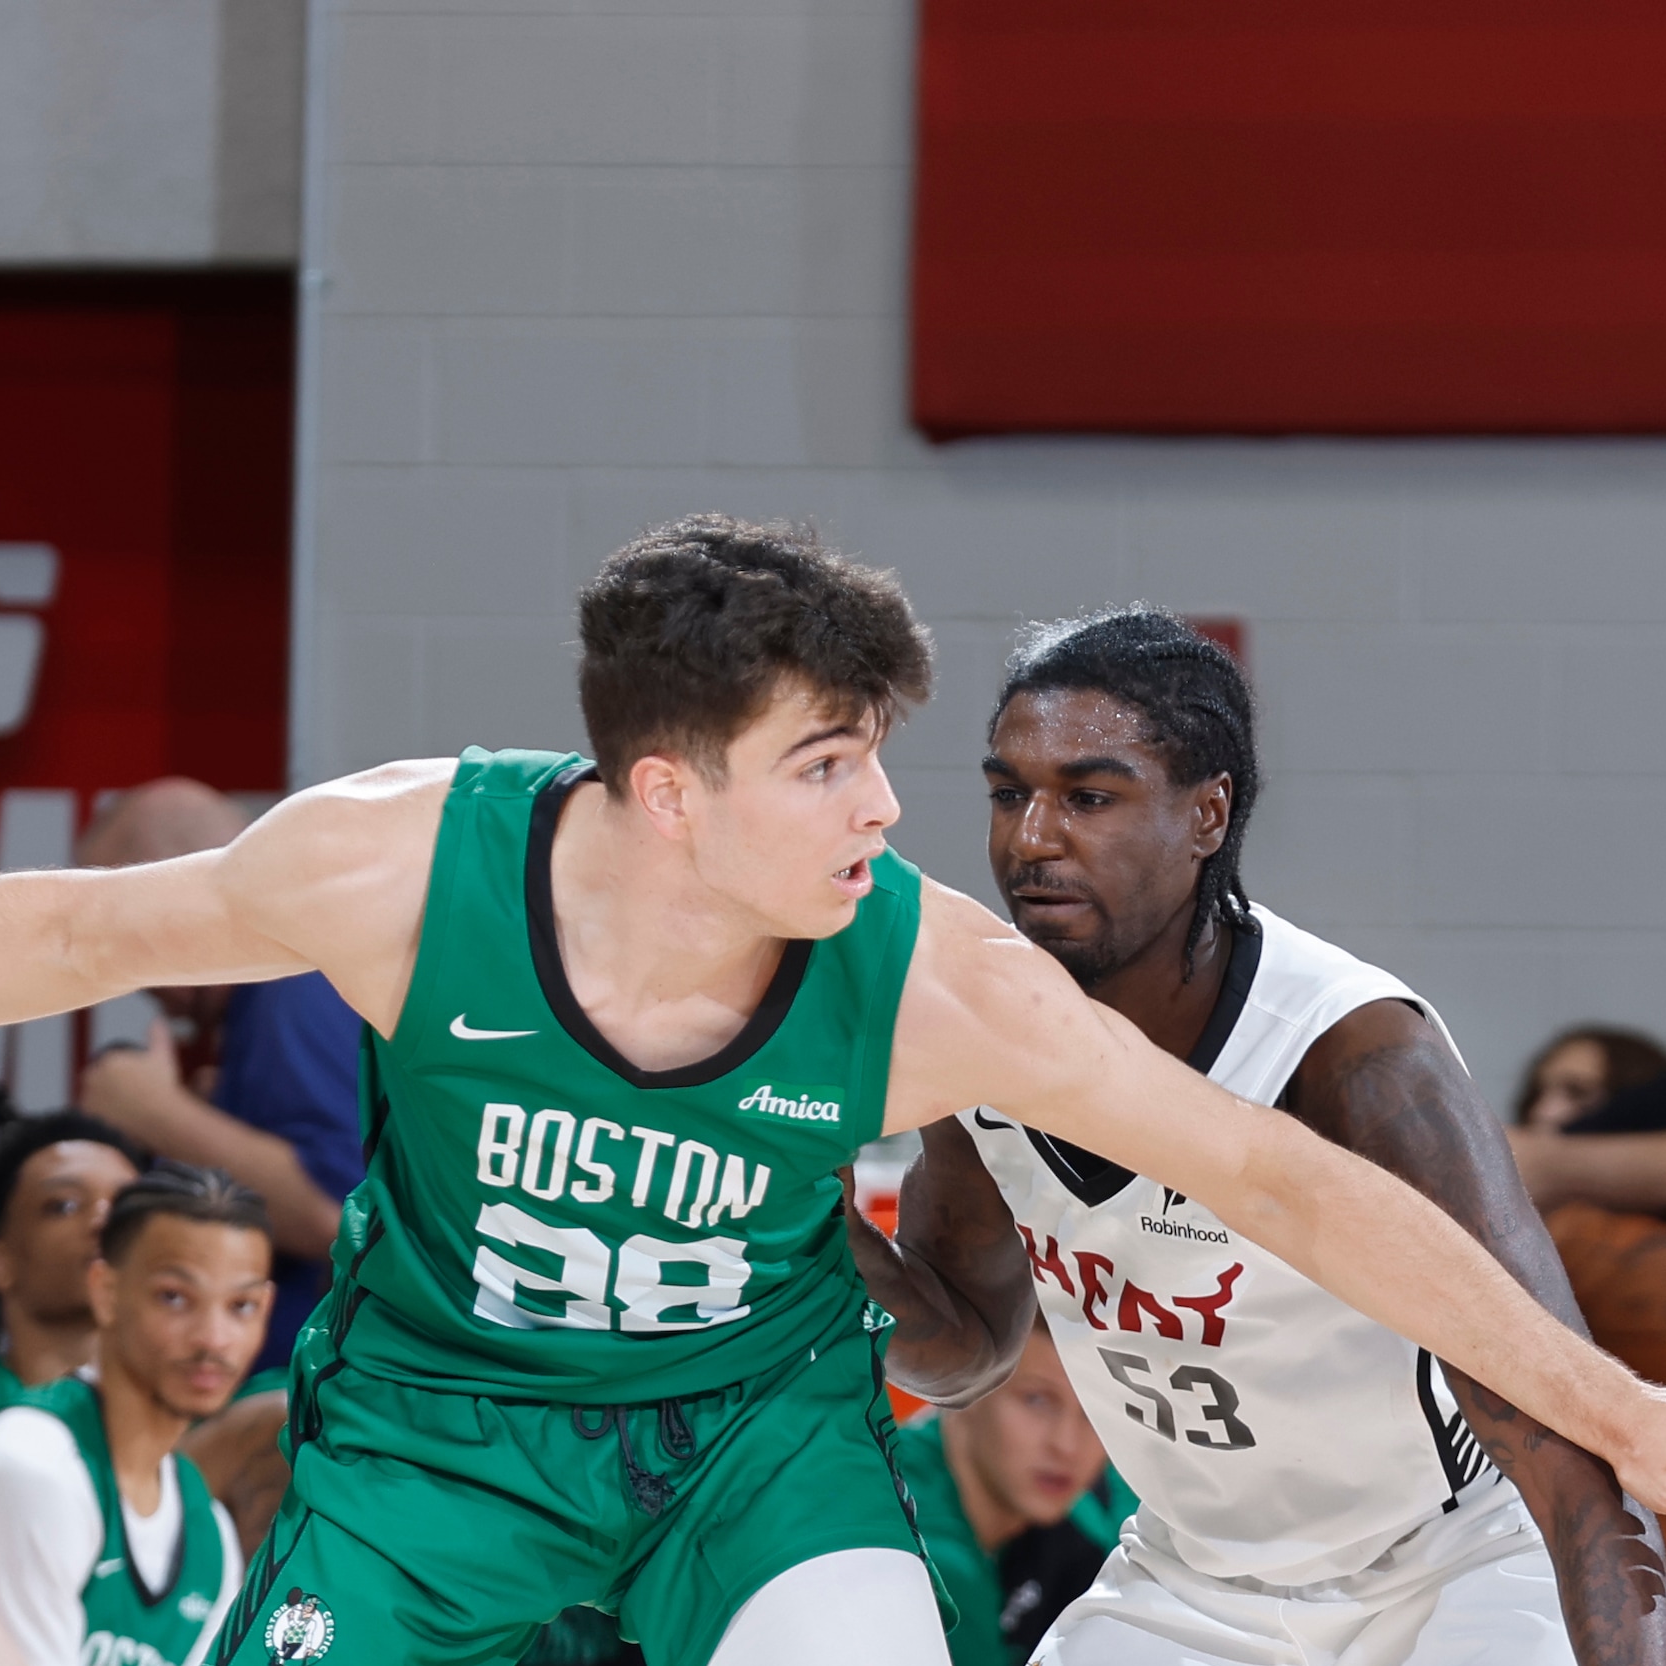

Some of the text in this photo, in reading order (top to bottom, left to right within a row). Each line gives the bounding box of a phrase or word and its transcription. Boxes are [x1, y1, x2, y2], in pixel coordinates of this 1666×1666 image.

[738, 1085, 840, 1122] Amica
[477, 1102, 771, 1229] BOSTON
[472, 1202, 752, 1332] 28
[1140, 1216, 1229, 1244] Robinhood
[1015, 1222, 1244, 1347] HEAT
[1096, 1346, 1257, 1451] 53
[264, 1603, 289, 1648] BOSTON
[314, 1610, 335, 1659] CELTICS
